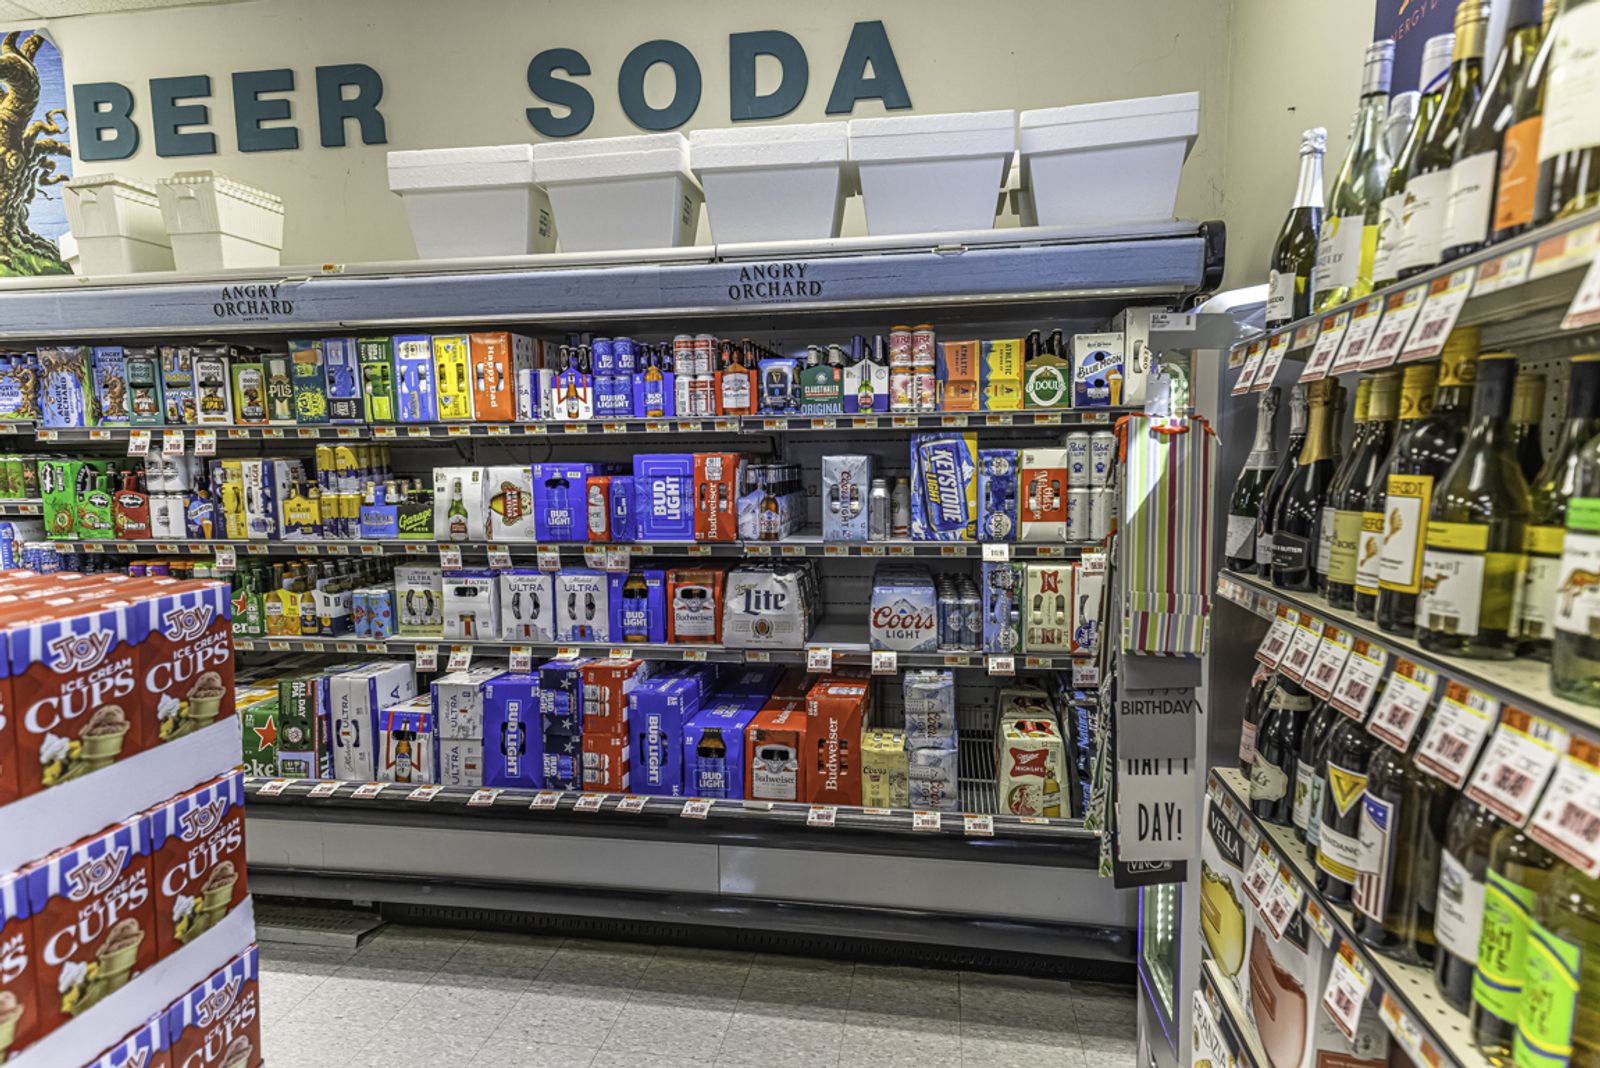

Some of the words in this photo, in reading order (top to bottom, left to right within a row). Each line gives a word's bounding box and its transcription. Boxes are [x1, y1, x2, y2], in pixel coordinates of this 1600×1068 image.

[525, 20, 912, 138] SODA
[73, 63, 388, 162] BEER
[739, 262, 808, 282] ANGRY
[222, 284, 280, 300] ANGRY
[728, 280, 824, 300] ORCHARD
[213, 300, 294, 318] ORCHARD
[1077, 363, 1099, 378] BLUE
[1100, 355, 1122, 369] MOON
[268, 384, 293, 397] PILS
[800, 403, 842, 415] ORIGINAL
[653, 480, 666, 516] BUD
[666, 476, 681, 520] LIGHT
[925, 472, 940, 505] LIGHT
[930, 448, 963, 523] KEYSTONE
[399, 508, 432, 530] Garage
[548, 517, 570, 525] LIGHT
[708, 483, 717, 538] Budweiser
[509, 584, 544, 592] ULTRA
[564, 584, 600, 592] ULTRA
[743, 588, 786, 615] Lite
[624, 618, 647, 626] LIGHT
[872, 606, 935, 629] Coors
[173, 643, 193, 660] ICE
[193, 630, 228, 650] CREAM
[886, 630, 920, 639] LIGHT
[60, 675, 87, 695] ICE
[88, 657, 132, 686] CREAM
[145, 641, 230, 694] CUPS
[24, 667, 136, 734] CUPS
[298, 700, 306, 718] DAY
[1121, 700, 1193, 715] BIRTHDAY
[508, 702, 518, 733] BUD
[649, 716, 658, 744] BUD
[1077, 706, 1089, 749] Natural
[452, 746, 460, 785] ULTRA
[508, 734, 518, 776] LIGHT
[649, 745, 659, 783] LIGHT
[825, 718, 838, 790] Budweiser
[699, 779, 725, 788] LIGHT
[702, 772, 722, 780] BUD
[188, 843, 207, 860] ICE
[208, 816, 241, 845] CREAM
[1138, 802, 1182, 841] DAY!
[1210, 811, 1241, 863] VELLA
[161, 826, 242, 897] CUPS
[78, 898, 101, 921] ICE
[103, 867, 146, 902] CREAM
[43, 879, 149, 966] CUPS
[204, 1024, 224, 1044] ICE
[223, 991, 255, 1025] CREAM
[181, 1008, 256, 1068] CUPS
